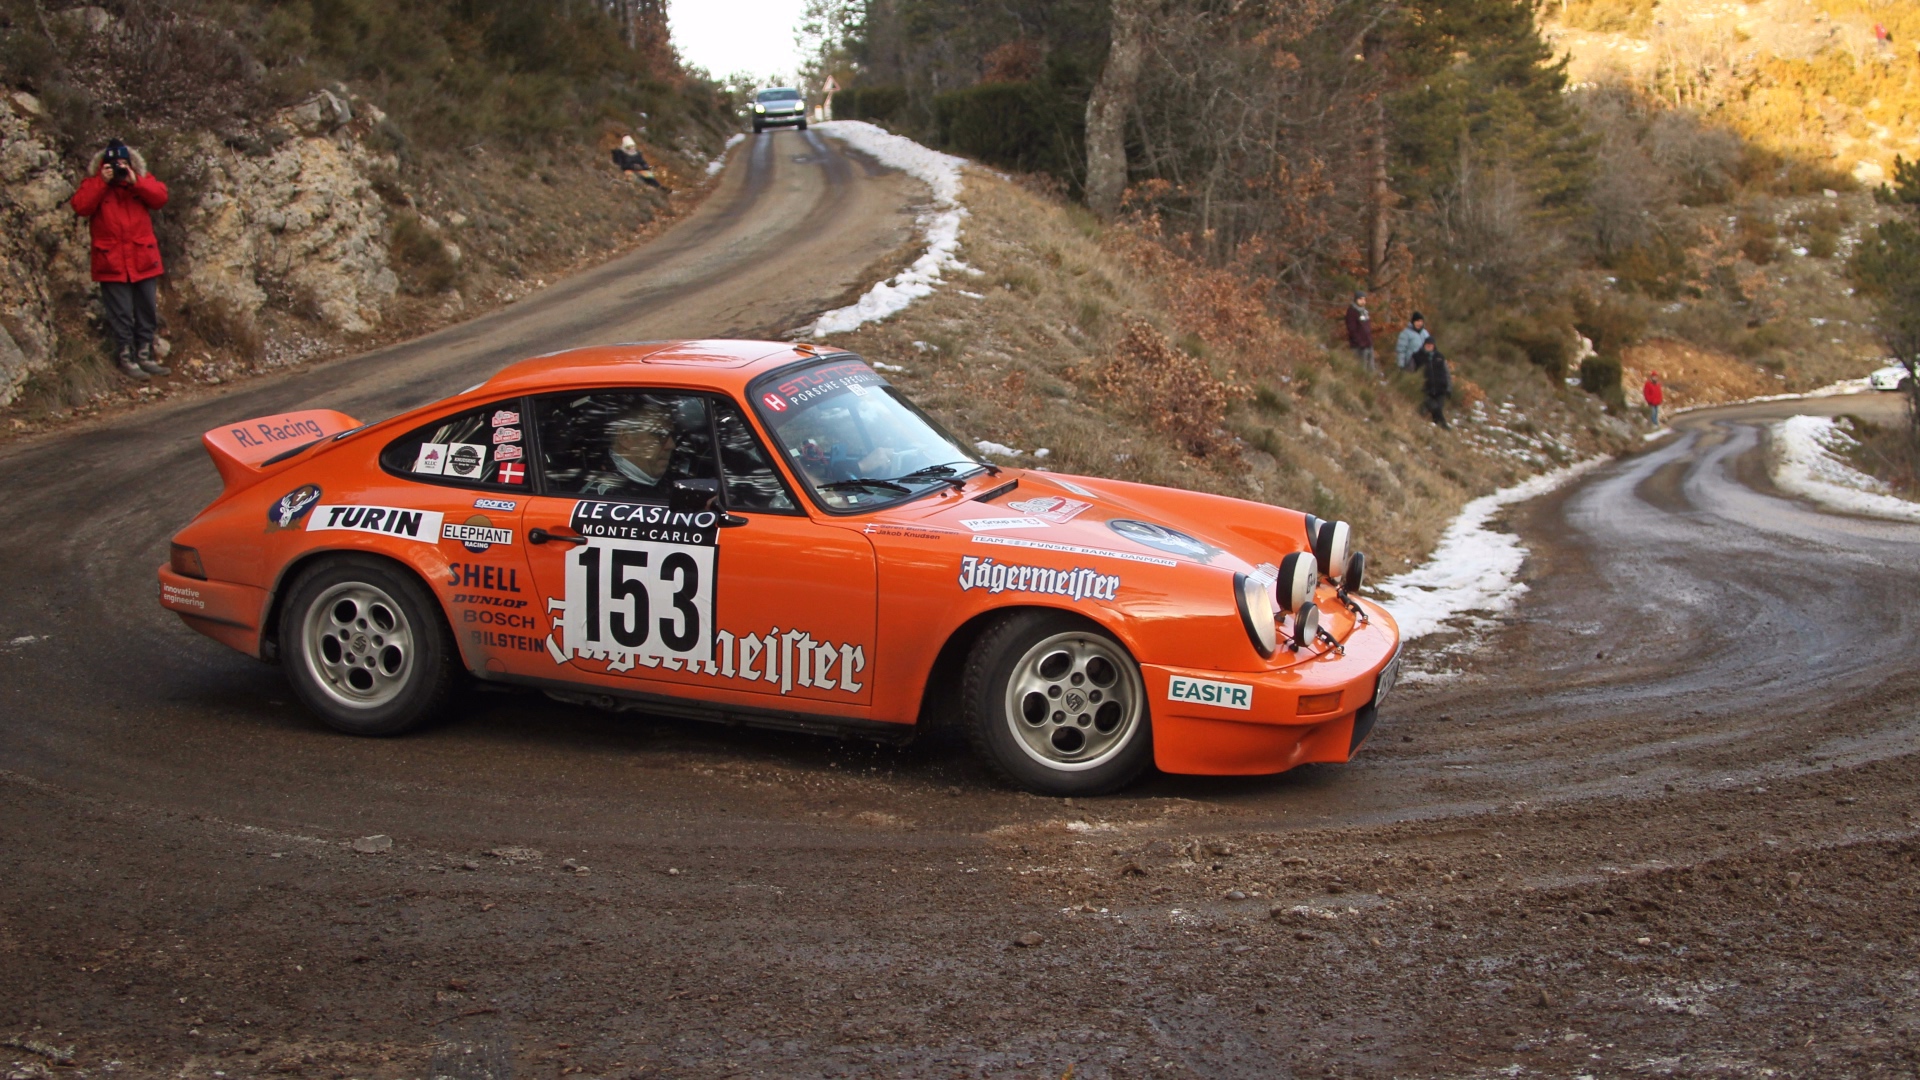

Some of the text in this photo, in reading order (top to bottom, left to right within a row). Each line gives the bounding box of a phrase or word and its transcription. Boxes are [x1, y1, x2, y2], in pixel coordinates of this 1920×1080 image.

[790, 380, 840, 406] PORSCHE
[231, 418, 324, 448] RL Racing
[474, 499, 516, 510] sparco
[578, 502, 716, 528] LE CASINO
[327, 507, 423, 537] TURIN
[443, 525, 511, 543] ELEPHANT
[464, 541, 489, 549] RACING
[876, 529, 941, 540] Jakob Knudsen
[974, 536, 1175, 566] TEAM FYNSKE BANK DANMARK
[447, 562, 521, 593] SHELL
[163, 582, 200, 598] innovative
[163, 593, 205, 609] engineering
[452, 593, 528, 609] DUNLOP
[578, 546, 700, 653] 153
[463, 609, 535, 630] BOSCH
[470, 630, 545, 653] BILSTEIN
